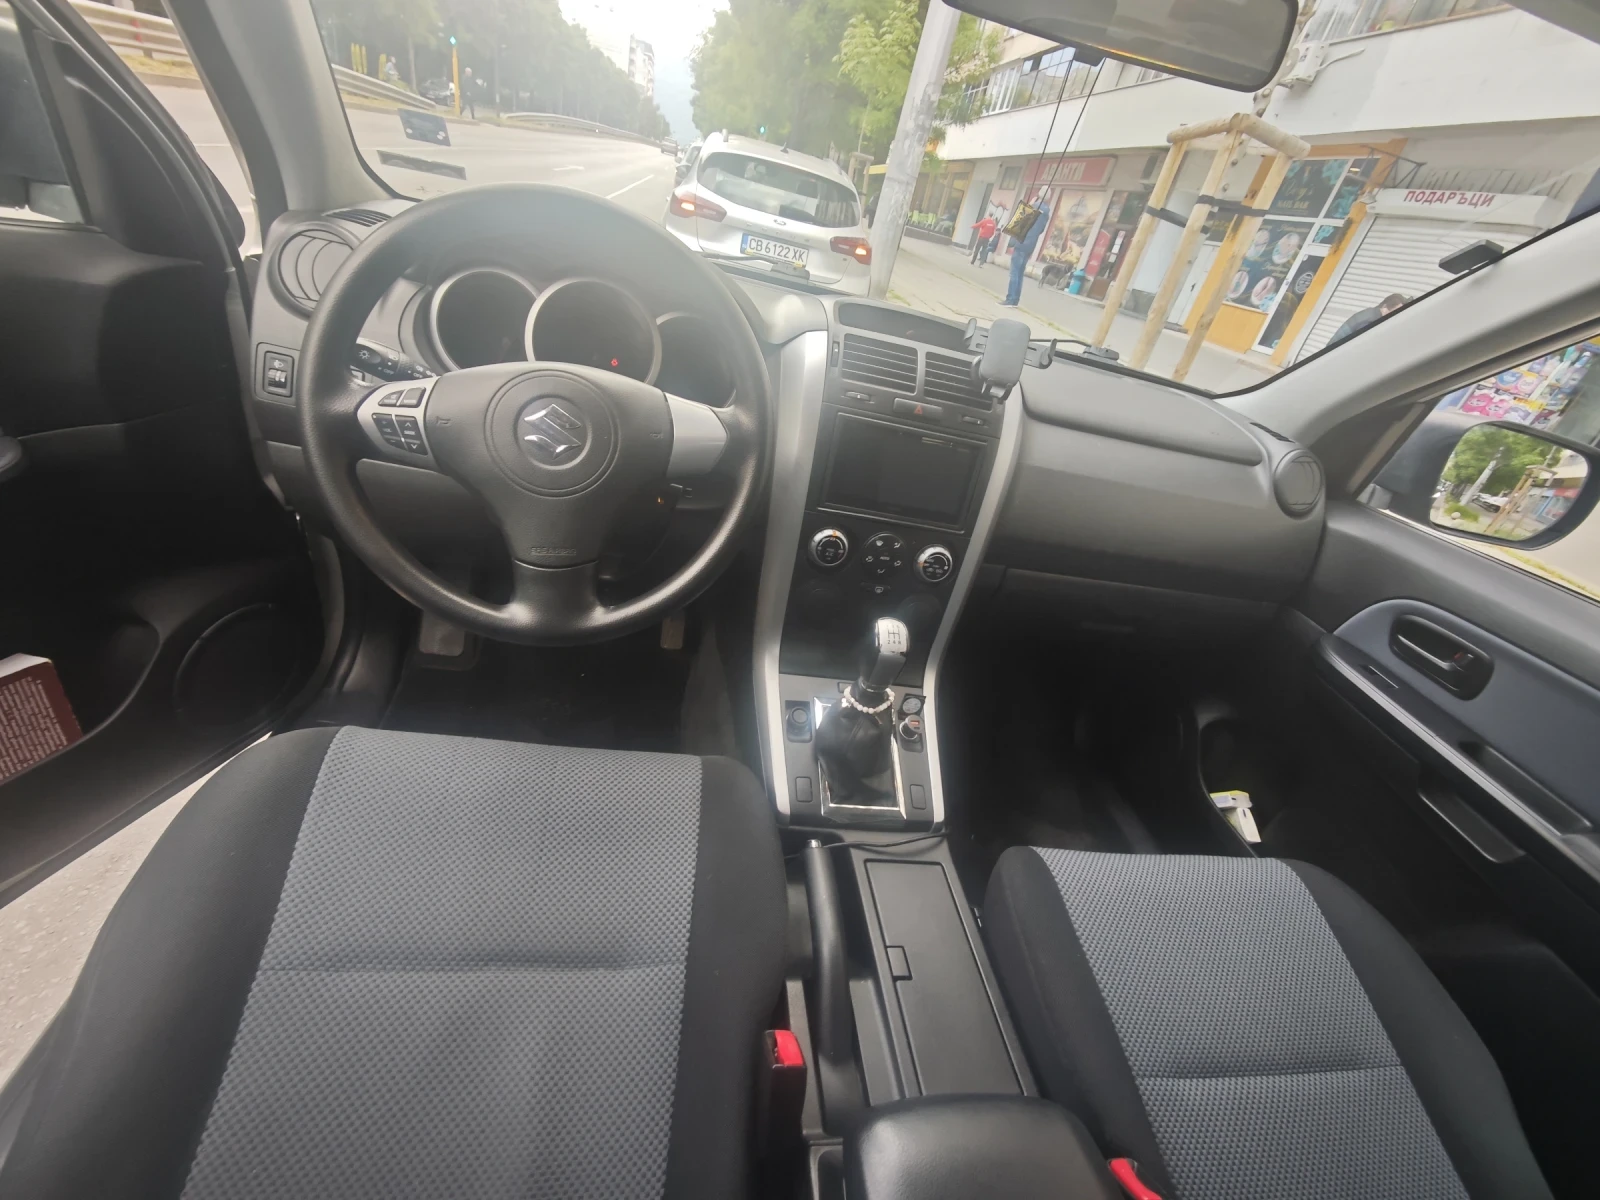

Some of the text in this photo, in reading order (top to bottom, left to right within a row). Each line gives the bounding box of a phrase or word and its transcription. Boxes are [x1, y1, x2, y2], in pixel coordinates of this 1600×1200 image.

[1041, 162, 1087, 181] АВАНТИ
[1403, 190, 1496, 209] ПОДАРЪЦИ
[749, 238, 806, 262] CB 6122 XK
